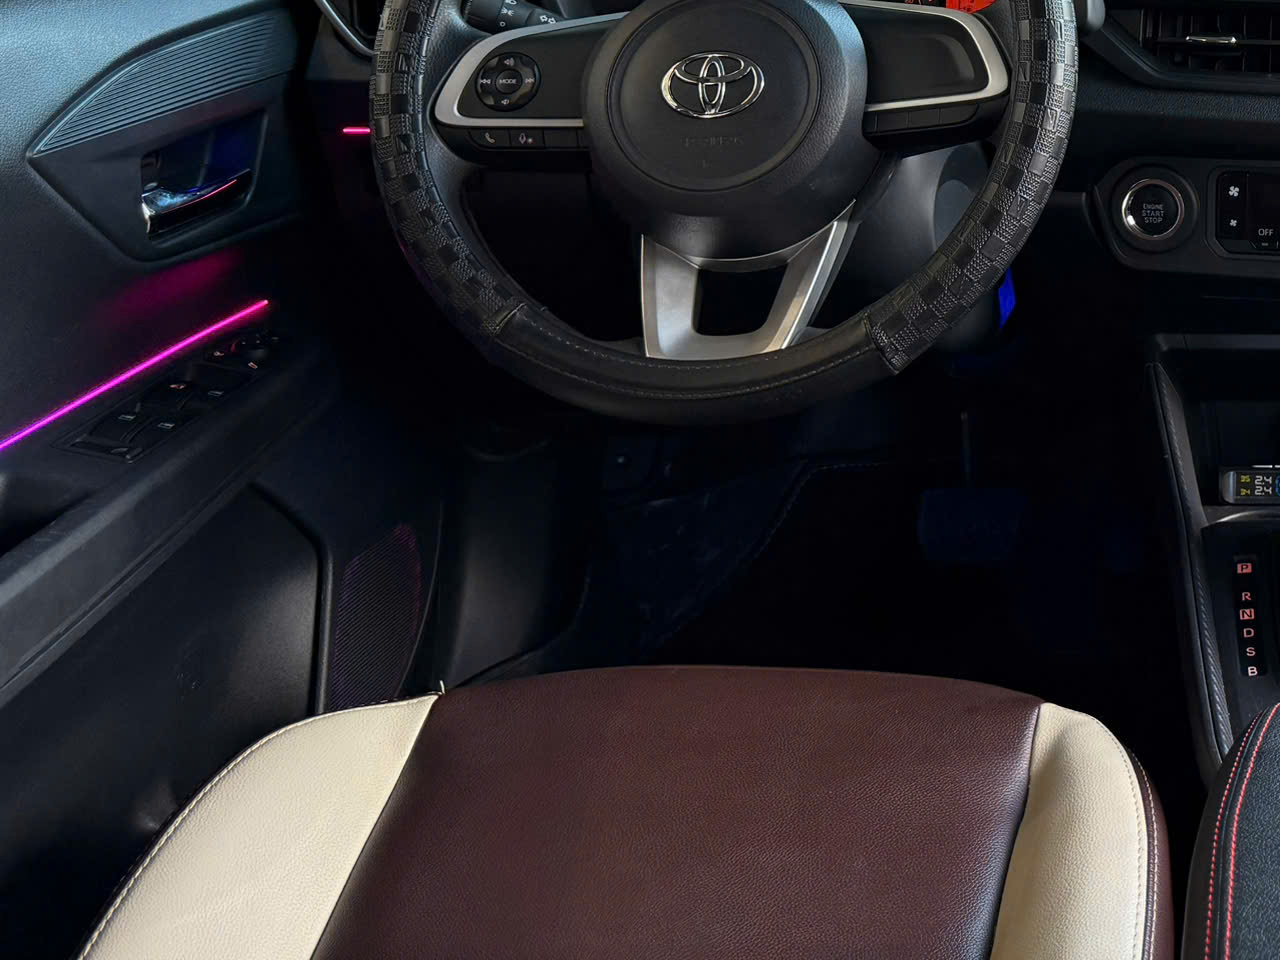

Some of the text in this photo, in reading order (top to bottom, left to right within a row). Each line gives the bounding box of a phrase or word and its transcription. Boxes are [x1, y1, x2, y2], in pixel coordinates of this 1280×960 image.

[1258, 228, 1274, 236] OFF
[1241, 592, 1252, 601] R
[1243, 628, 1255, 638] D
[1246, 647, 1256, 657] S
[1247, 666, 1258, 676] B
